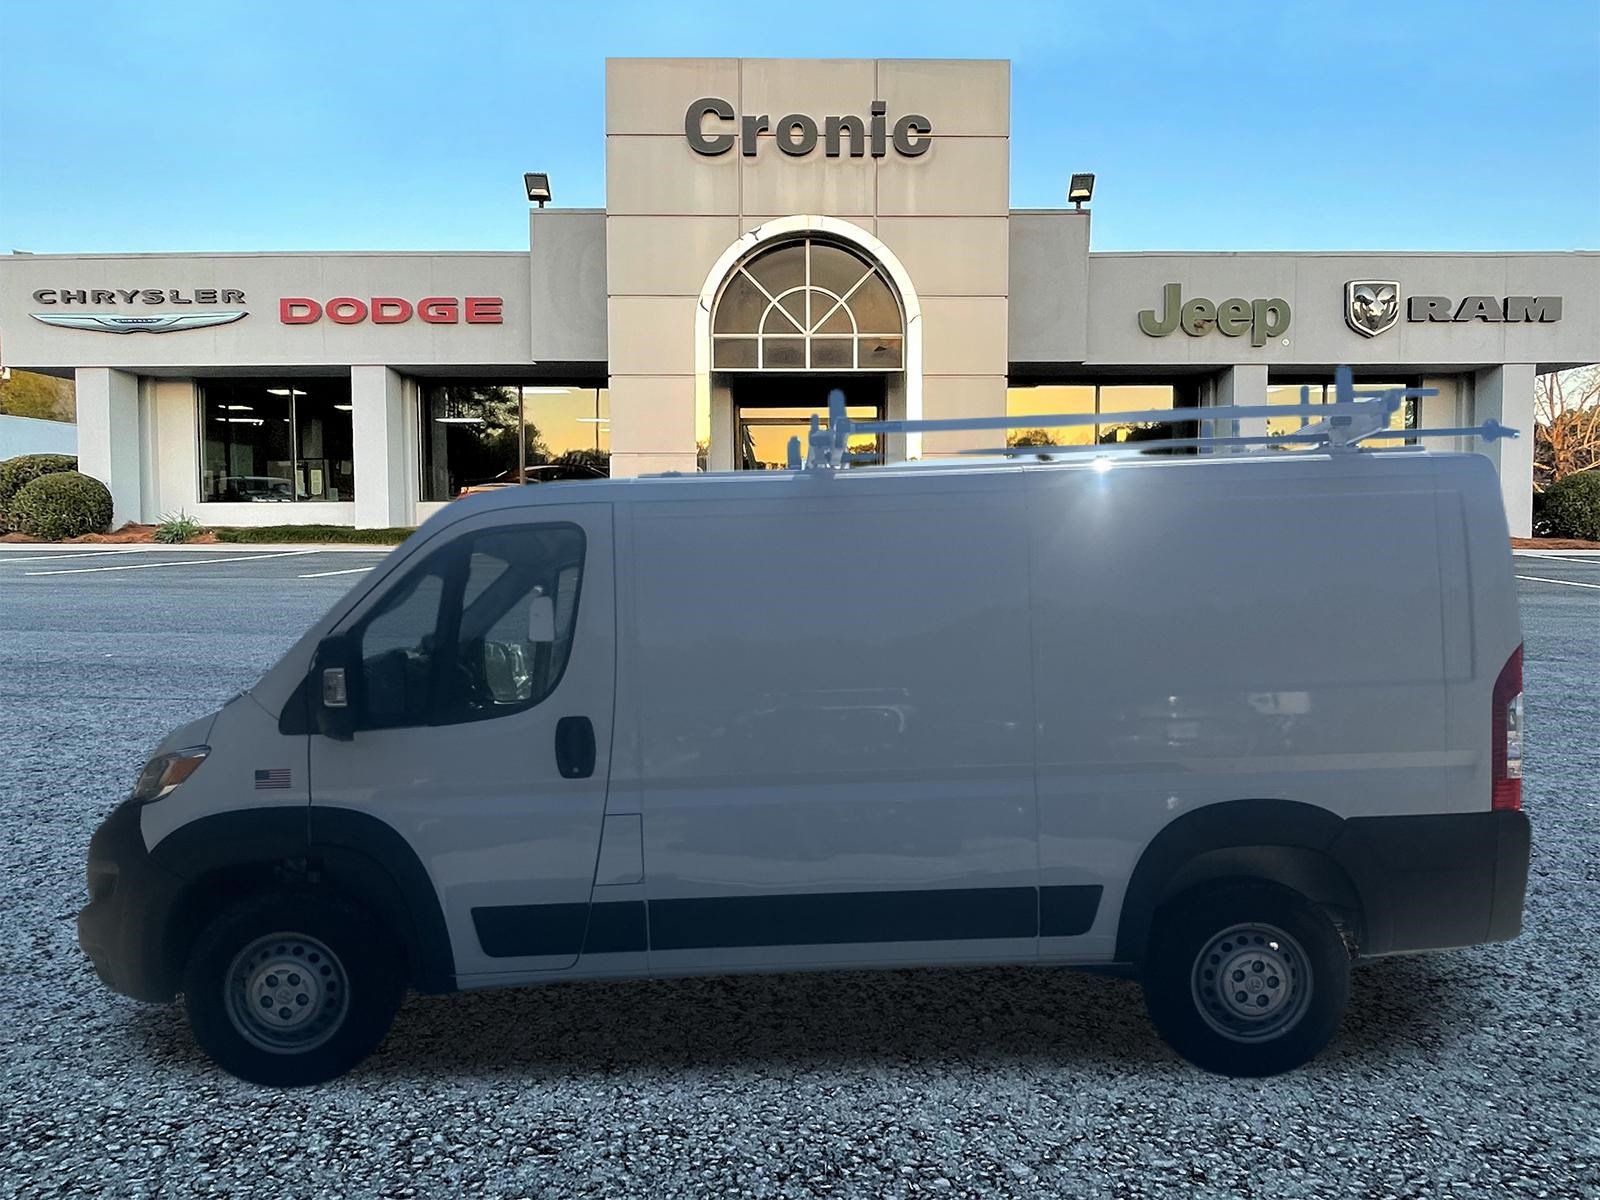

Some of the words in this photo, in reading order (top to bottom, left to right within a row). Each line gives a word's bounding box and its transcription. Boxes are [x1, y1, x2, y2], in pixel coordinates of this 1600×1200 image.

[685, 97, 932, 157] Cronic
[32, 287, 247, 305] CHRYSLER
[280, 296, 504, 325] DODGE
[1407, 296, 1562, 322] RAM
[1138, 283, 1291, 346] Jeep
